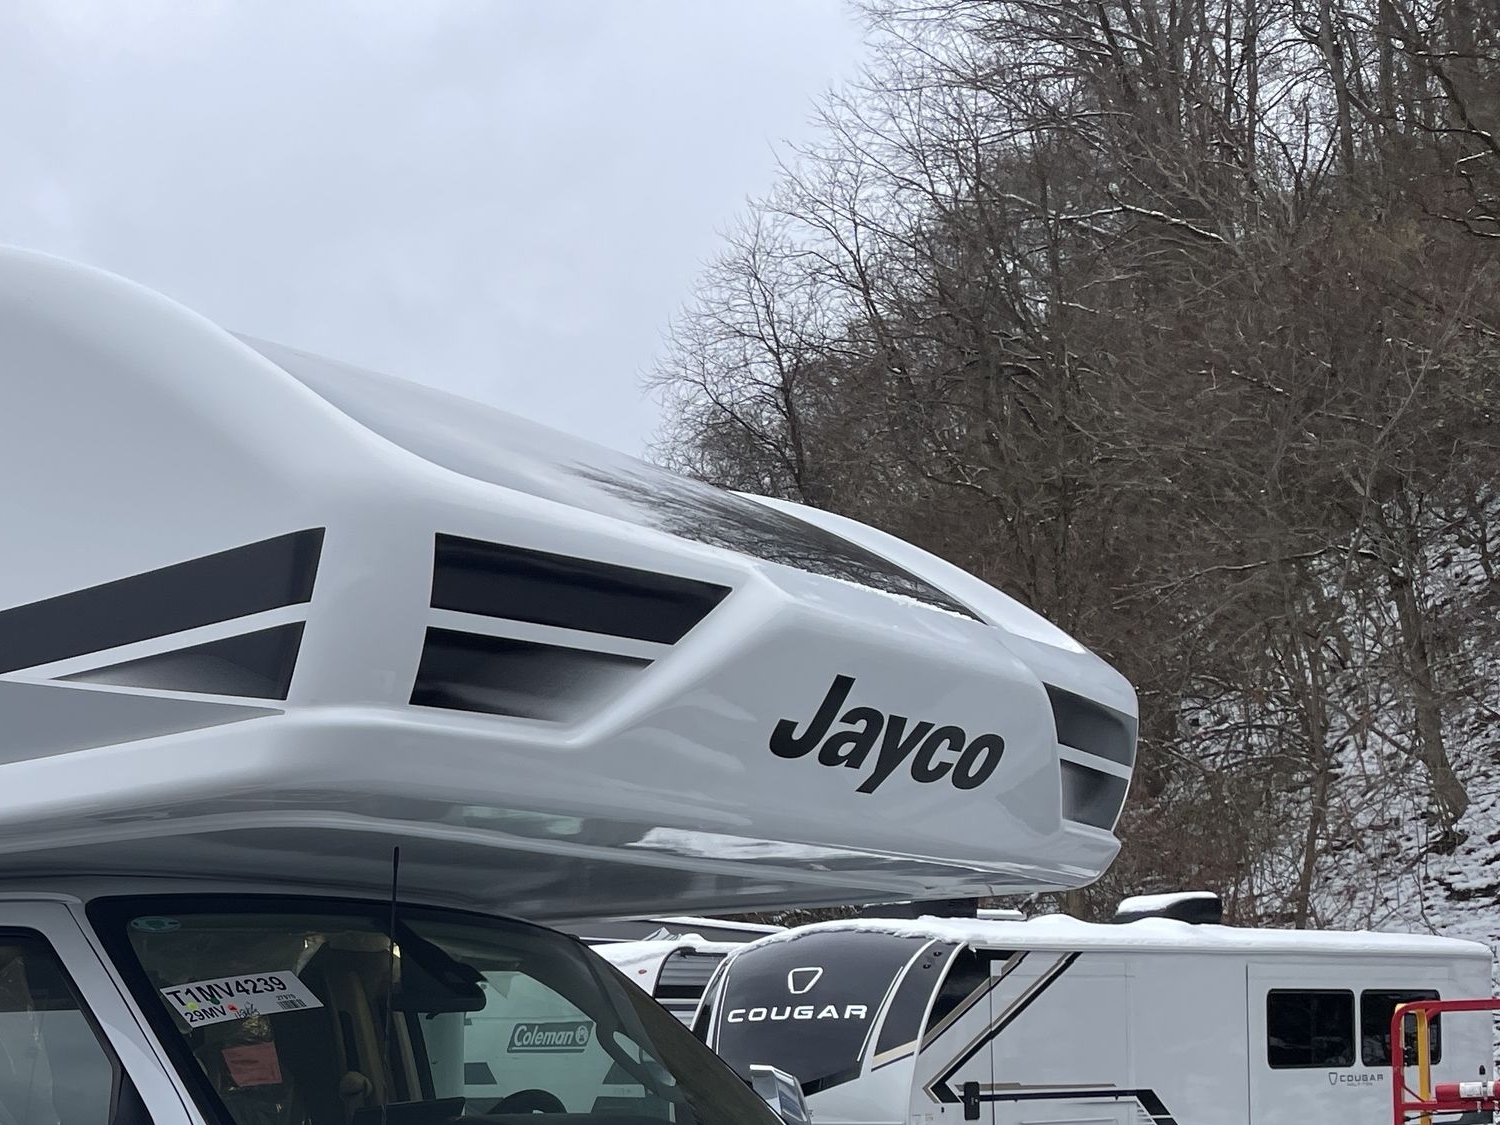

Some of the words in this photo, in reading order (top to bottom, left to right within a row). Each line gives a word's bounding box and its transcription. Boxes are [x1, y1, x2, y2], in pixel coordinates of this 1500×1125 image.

[769, 674, 1005, 794] Jayco
[165, 976, 287, 1007] T1MV4239
[184, 1005, 227, 1023] 29MV
[727, 1004, 868, 1023] COUGAR
[514, 1025, 574, 1046] Coleman
[1339, 1073, 1384, 1083] COUGAR
